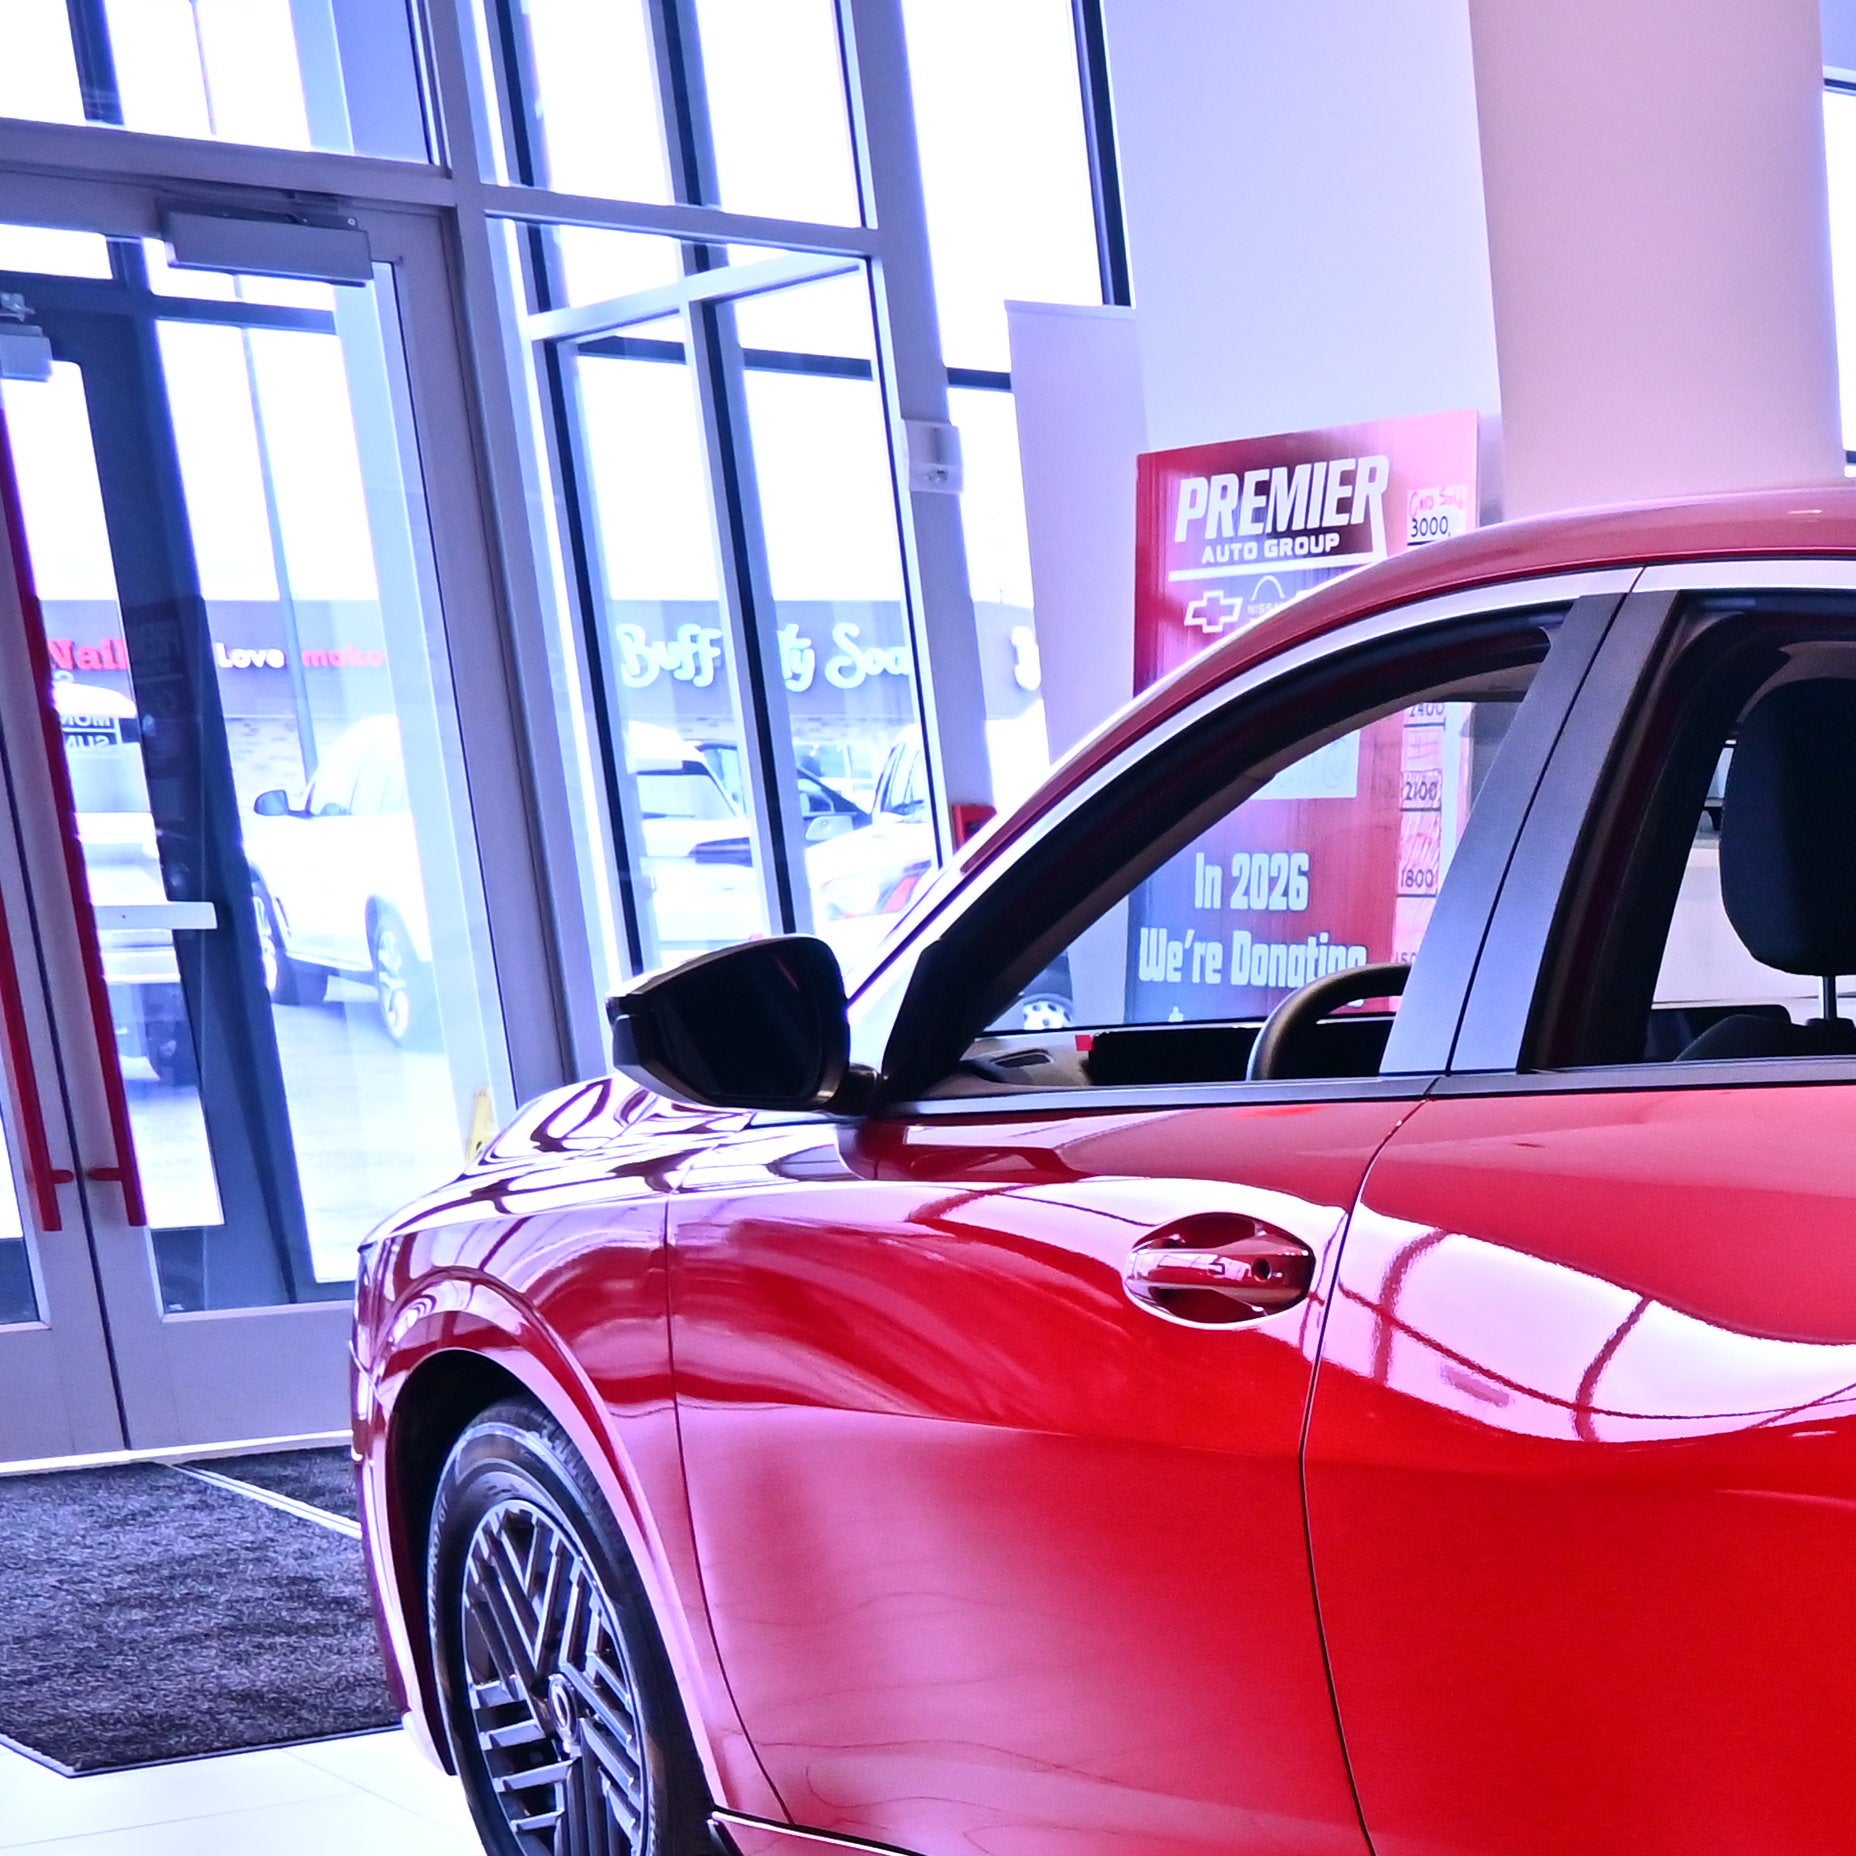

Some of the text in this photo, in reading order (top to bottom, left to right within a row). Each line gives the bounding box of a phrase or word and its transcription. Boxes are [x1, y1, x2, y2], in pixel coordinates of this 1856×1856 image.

[1174, 454, 1390, 544] PREMIER
[1201, 532, 1340, 564] AUTO GROUP
[213, 642, 285, 668] Love
[615, 623, 722, 688] Buff
[825, 622, 909, 689] Soa
[1405, 780, 1438, 801] 2100
[1194, 852, 1310, 912] In 2026
[1400, 868, 1434, 888] 1800
[1138, 927, 1223, 985] We're
